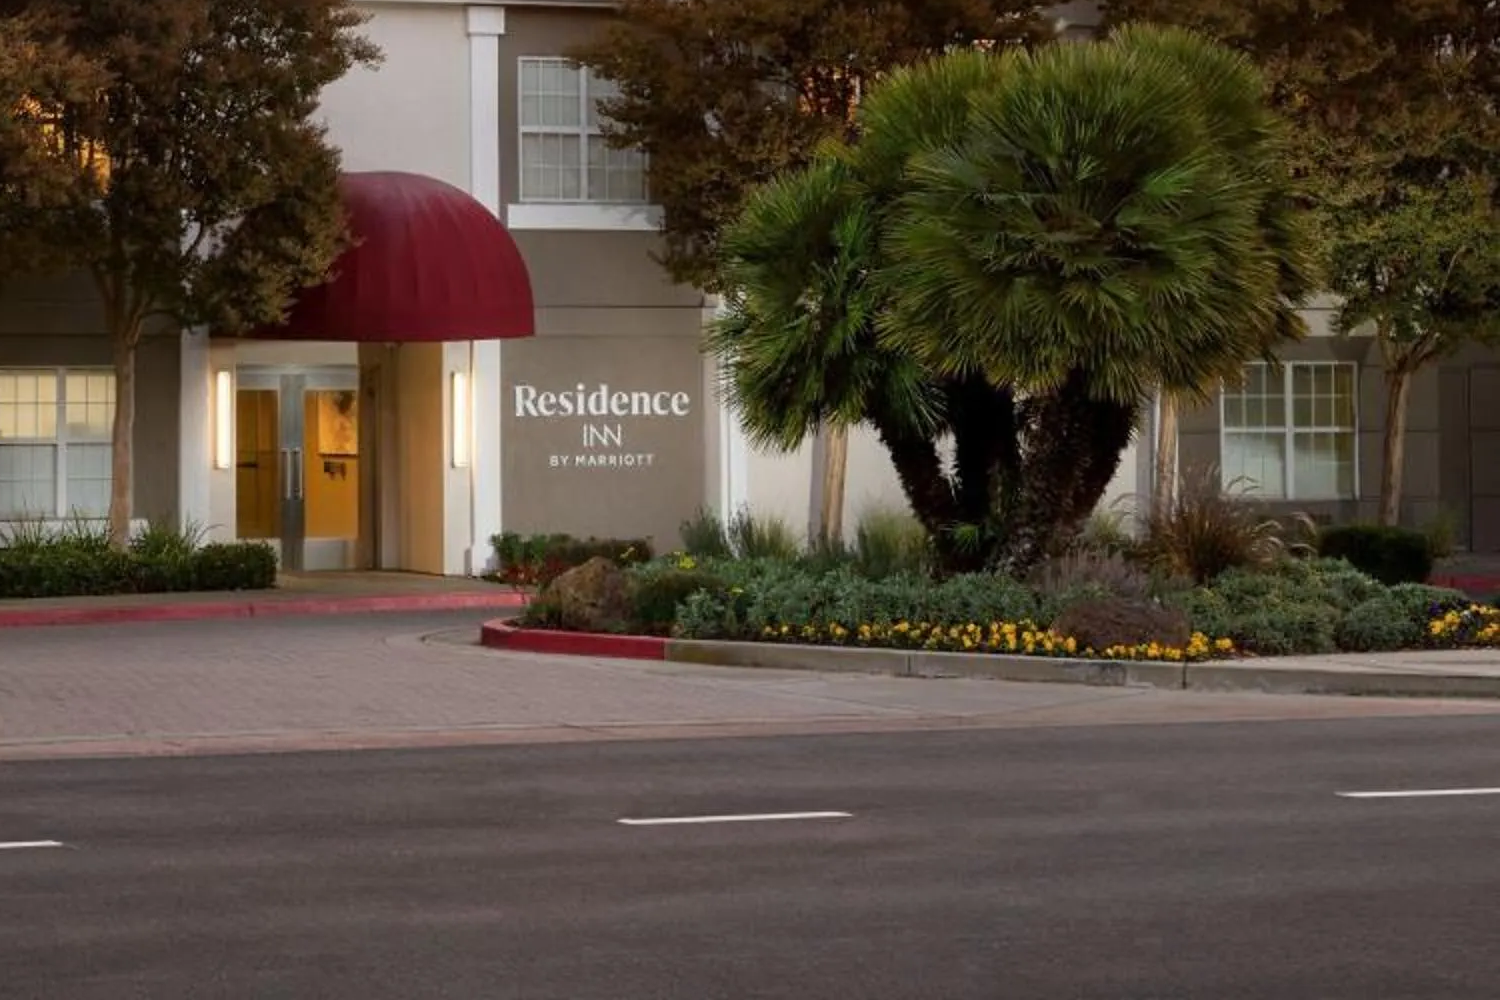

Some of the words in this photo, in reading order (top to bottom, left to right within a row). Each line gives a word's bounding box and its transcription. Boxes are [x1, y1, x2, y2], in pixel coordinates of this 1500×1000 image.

[514, 383, 690, 417] Residence
[583, 424, 622, 447] INN
[550, 455, 568, 467] BY
[575, 454, 655, 467] MARRIOTT
